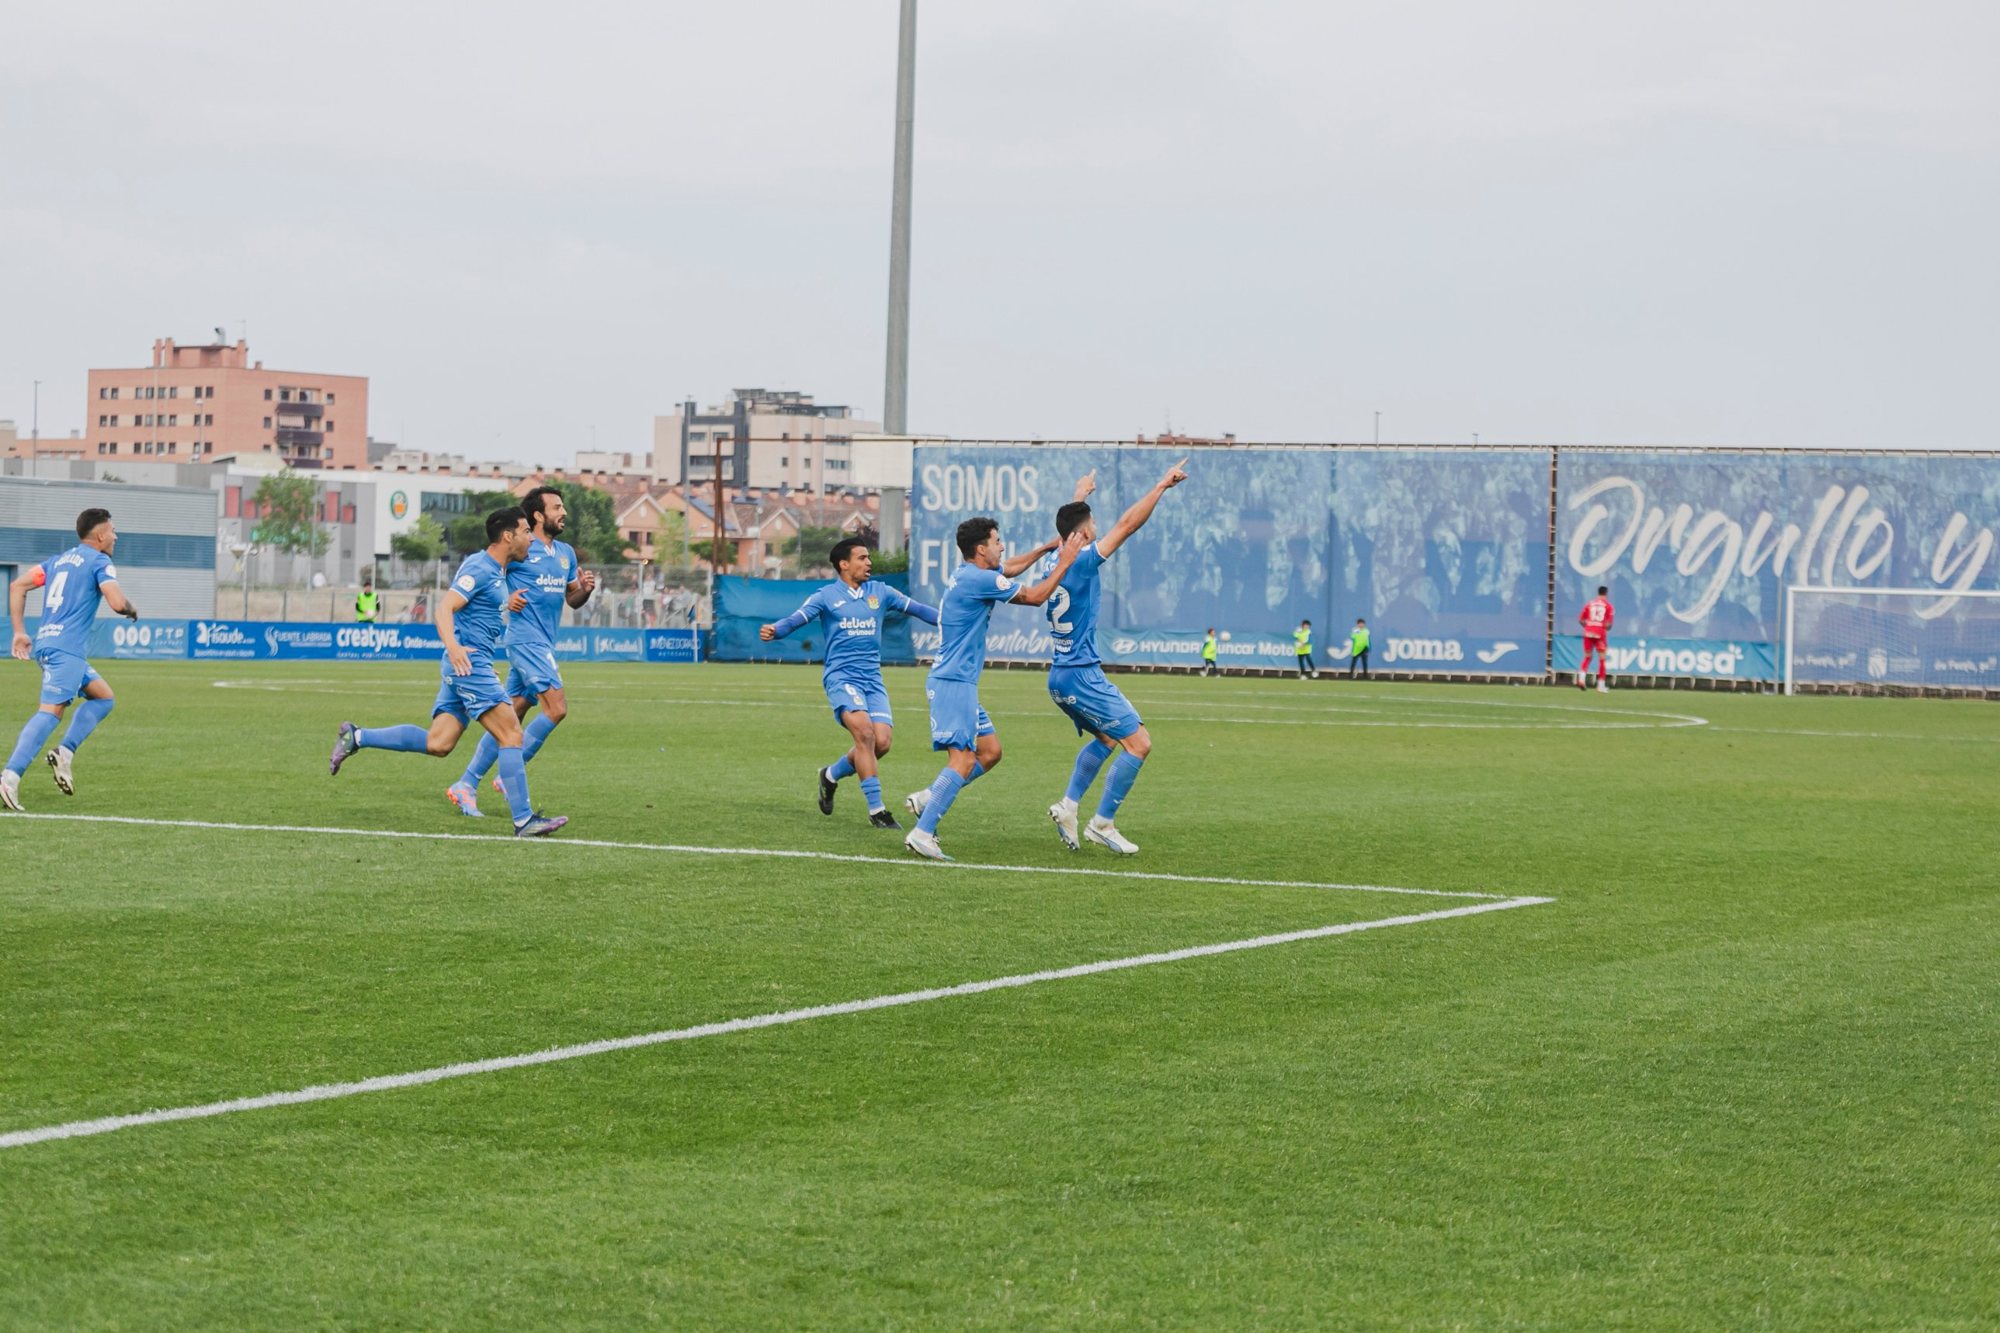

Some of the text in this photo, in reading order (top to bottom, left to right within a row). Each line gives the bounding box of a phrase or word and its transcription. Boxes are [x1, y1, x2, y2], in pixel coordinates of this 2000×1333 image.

[922, 464, 1039, 512] SOMOS
[1568, 475, 1994, 623] Orgullo y
[46, 571, 69, 614] 4
[1140, 639, 1297, 656] HYUNDA uncar Moto
[1606, 639, 1736, 675] avimosa
